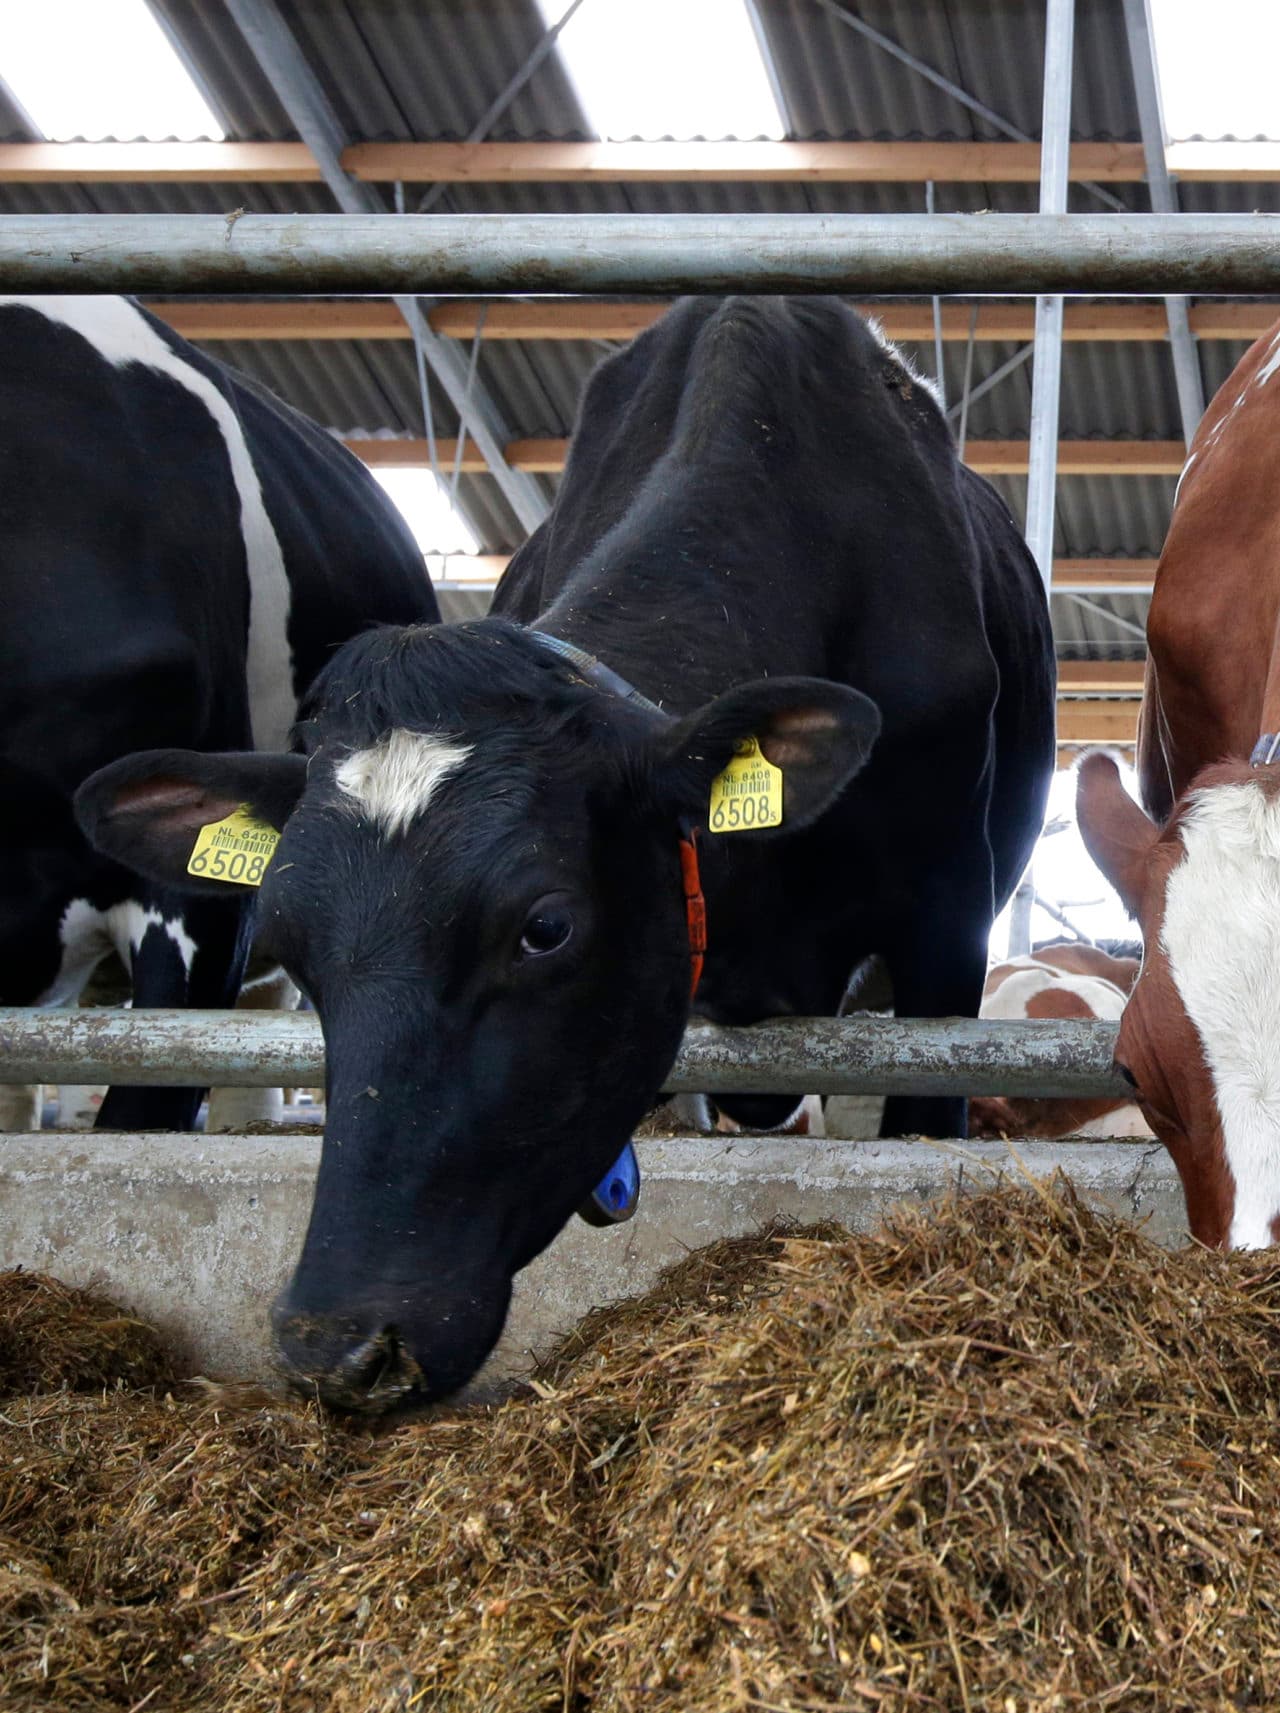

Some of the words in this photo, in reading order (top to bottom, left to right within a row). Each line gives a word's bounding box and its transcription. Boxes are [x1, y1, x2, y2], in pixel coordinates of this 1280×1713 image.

[713, 795, 769, 828] 6508
[219, 826, 235, 837] NL
[241, 830, 277, 843] 8408
[190, 847, 265, 882] 6508
